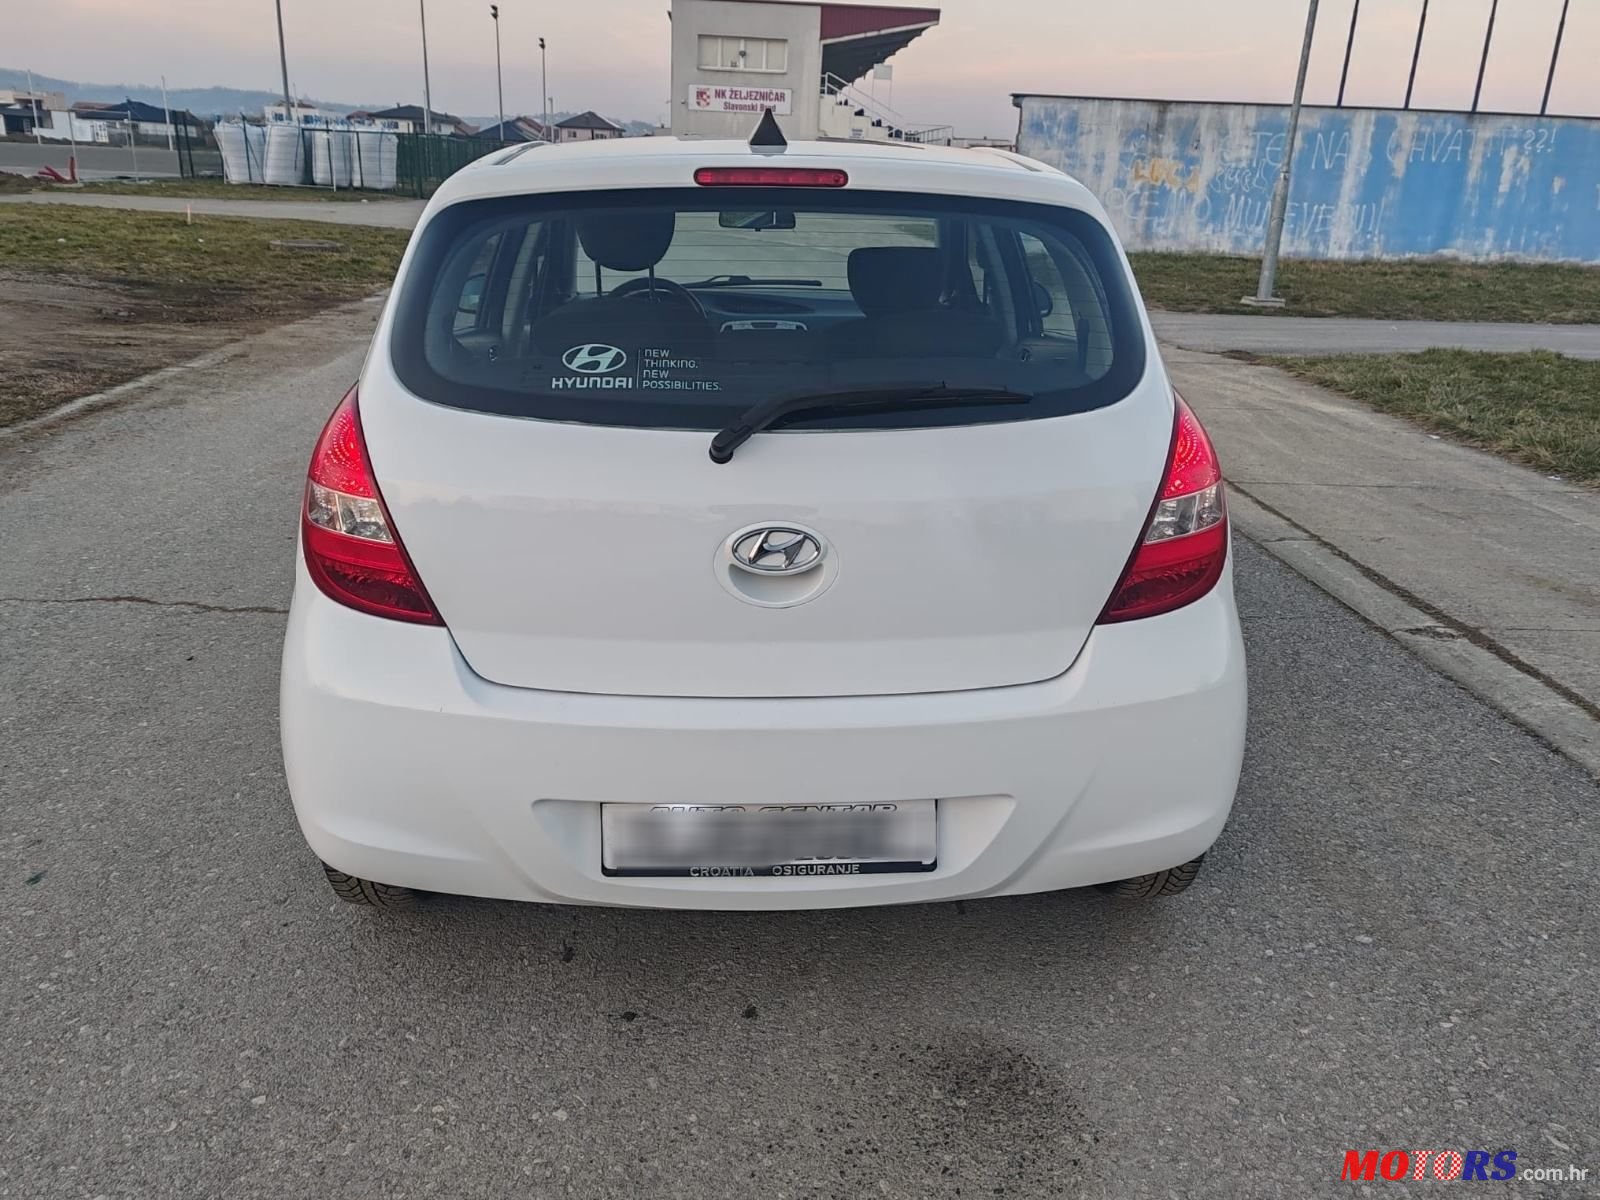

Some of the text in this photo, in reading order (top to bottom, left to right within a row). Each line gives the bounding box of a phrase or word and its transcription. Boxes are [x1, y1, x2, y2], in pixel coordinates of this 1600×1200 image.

[714, 88, 786, 103] NK ŽELJEZNIČAR
[723, 101, 758, 112] Slavonski
[644, 359, 699, 369] THINKING.
[551, 377, 632, 389] HYUNDAI
[642, 380, 722, 391] POSSIBILITIES.
[690, 863, 861, 877] CROATIA OSIGURANJE
